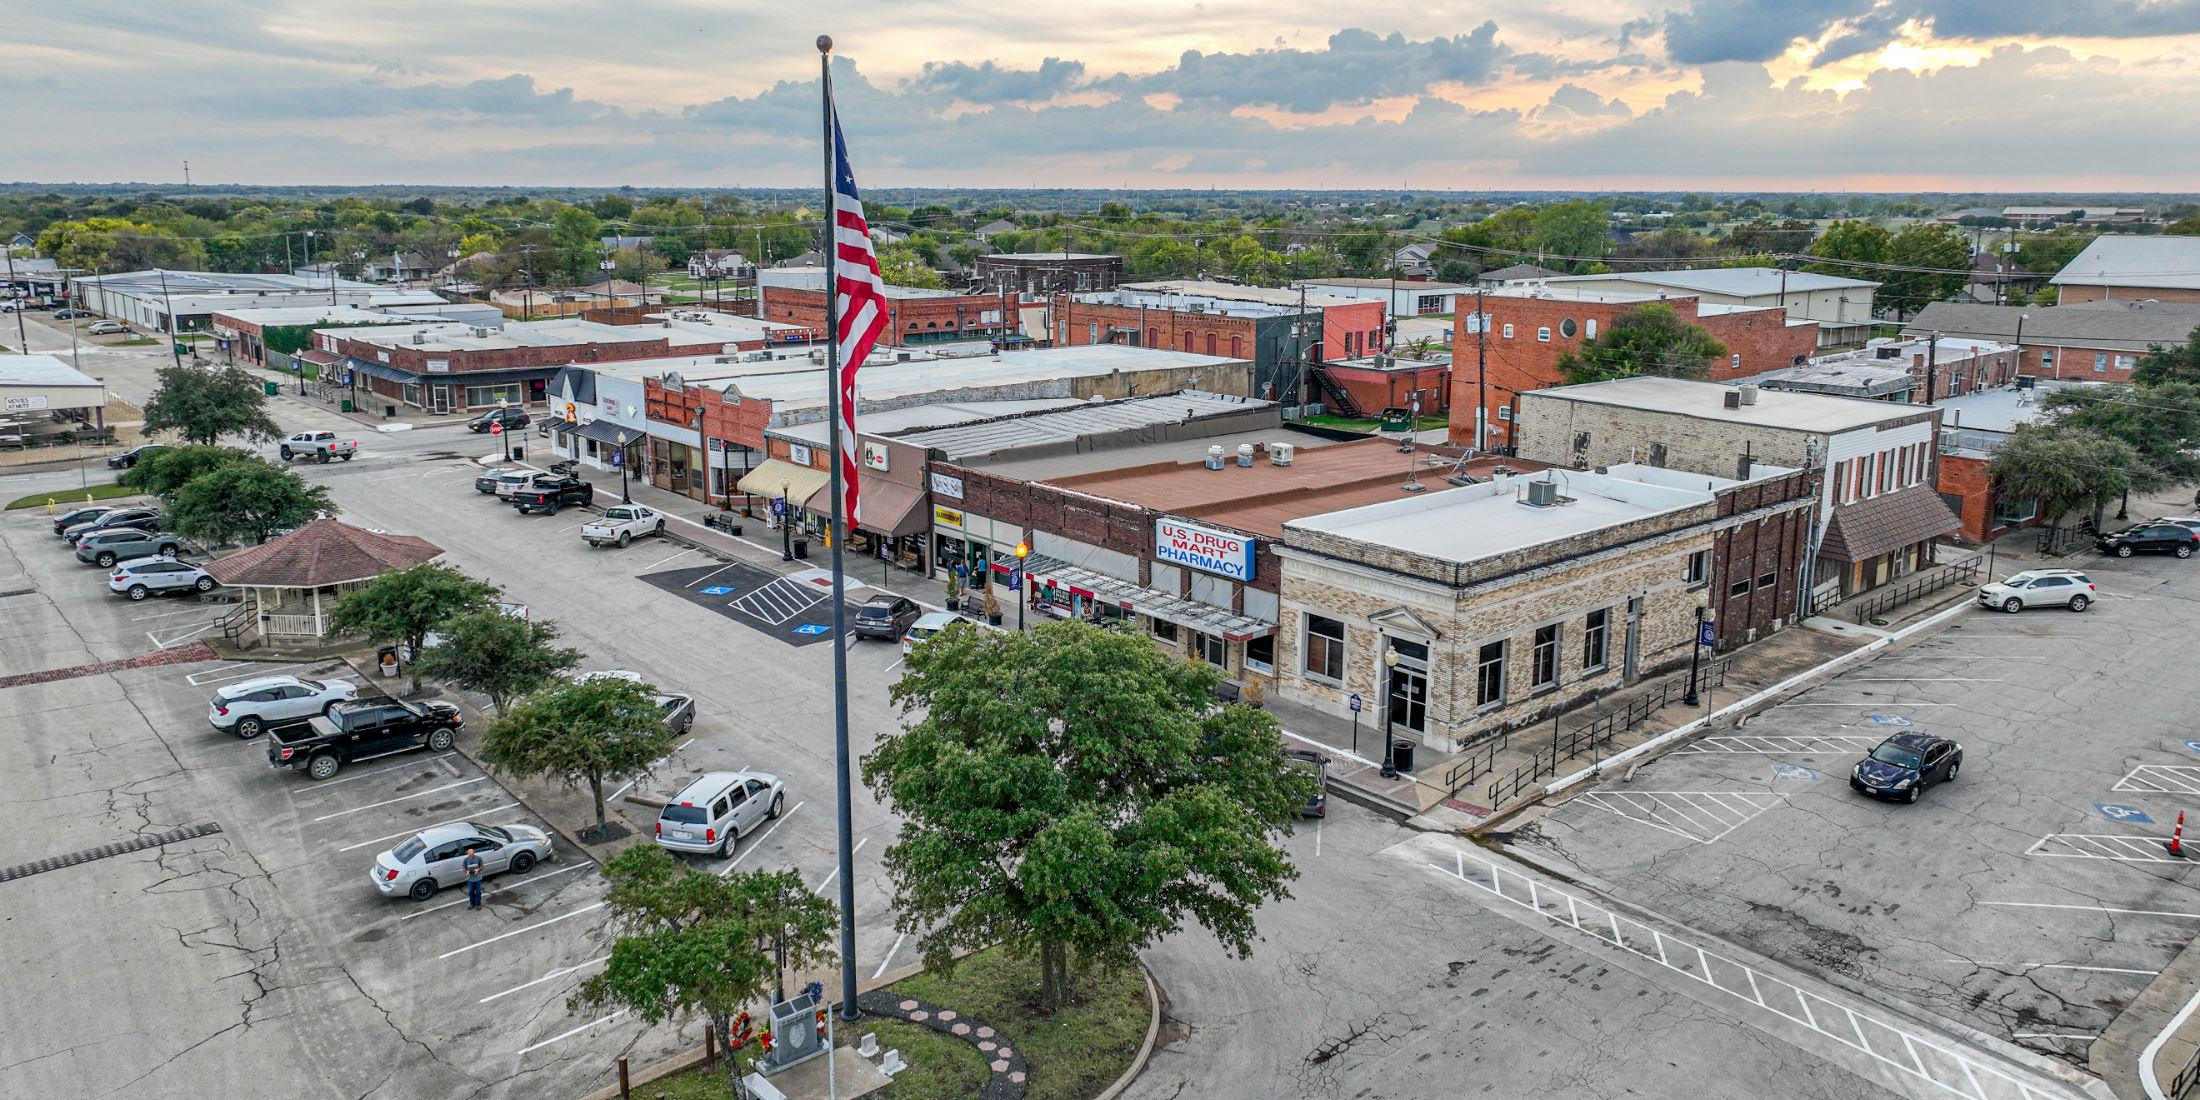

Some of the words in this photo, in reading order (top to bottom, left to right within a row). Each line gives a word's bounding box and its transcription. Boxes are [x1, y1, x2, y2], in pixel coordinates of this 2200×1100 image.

[1162, 526, 1190, 541] U.S.
[1194, 533, 1239, 552] DRUG
[1172, 539, 1228, 558] MART
[1158, 545, 1243, 575] PHARMACY
